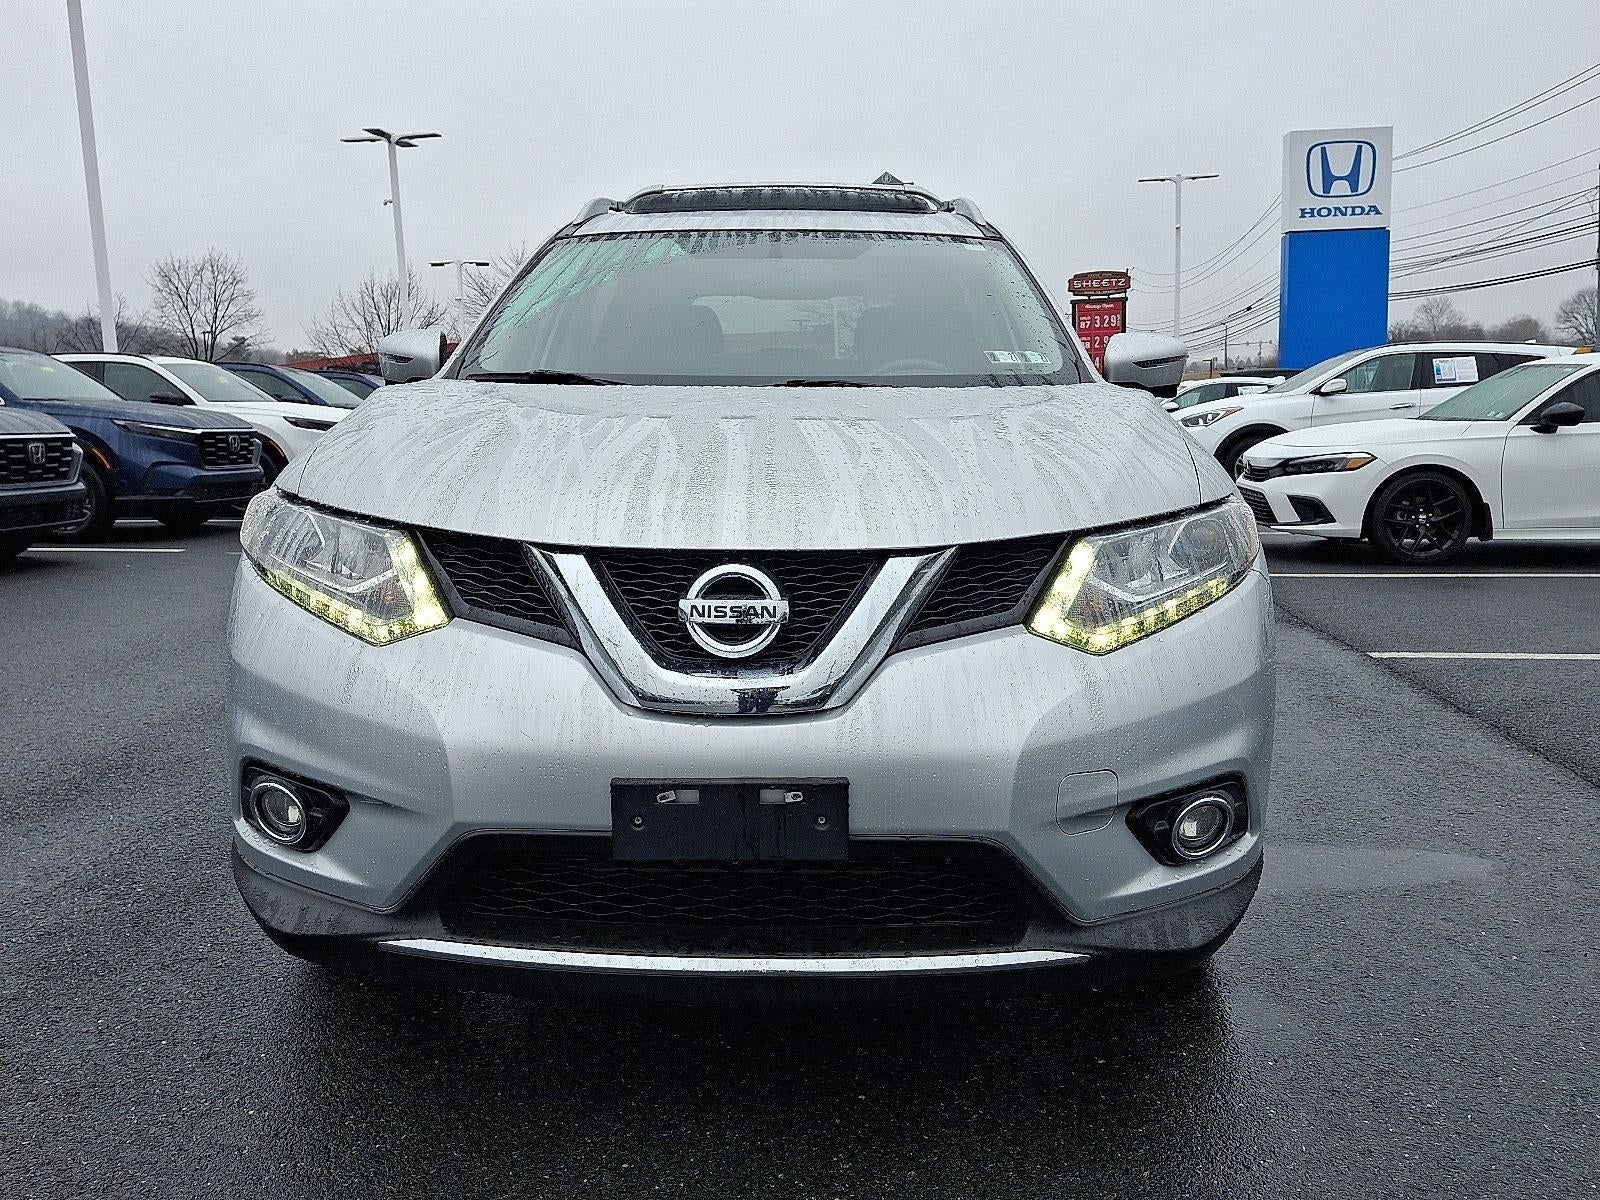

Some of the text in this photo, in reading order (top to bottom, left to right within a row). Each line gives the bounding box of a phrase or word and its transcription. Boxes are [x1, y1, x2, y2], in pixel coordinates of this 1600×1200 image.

[1298, 204, 1383, 218] HONDA
[1073, 278, 1126, 289] SHEETZ
[1079, 320, 1092, 329] 87
[690, 604, 777, 619] NISSAN
